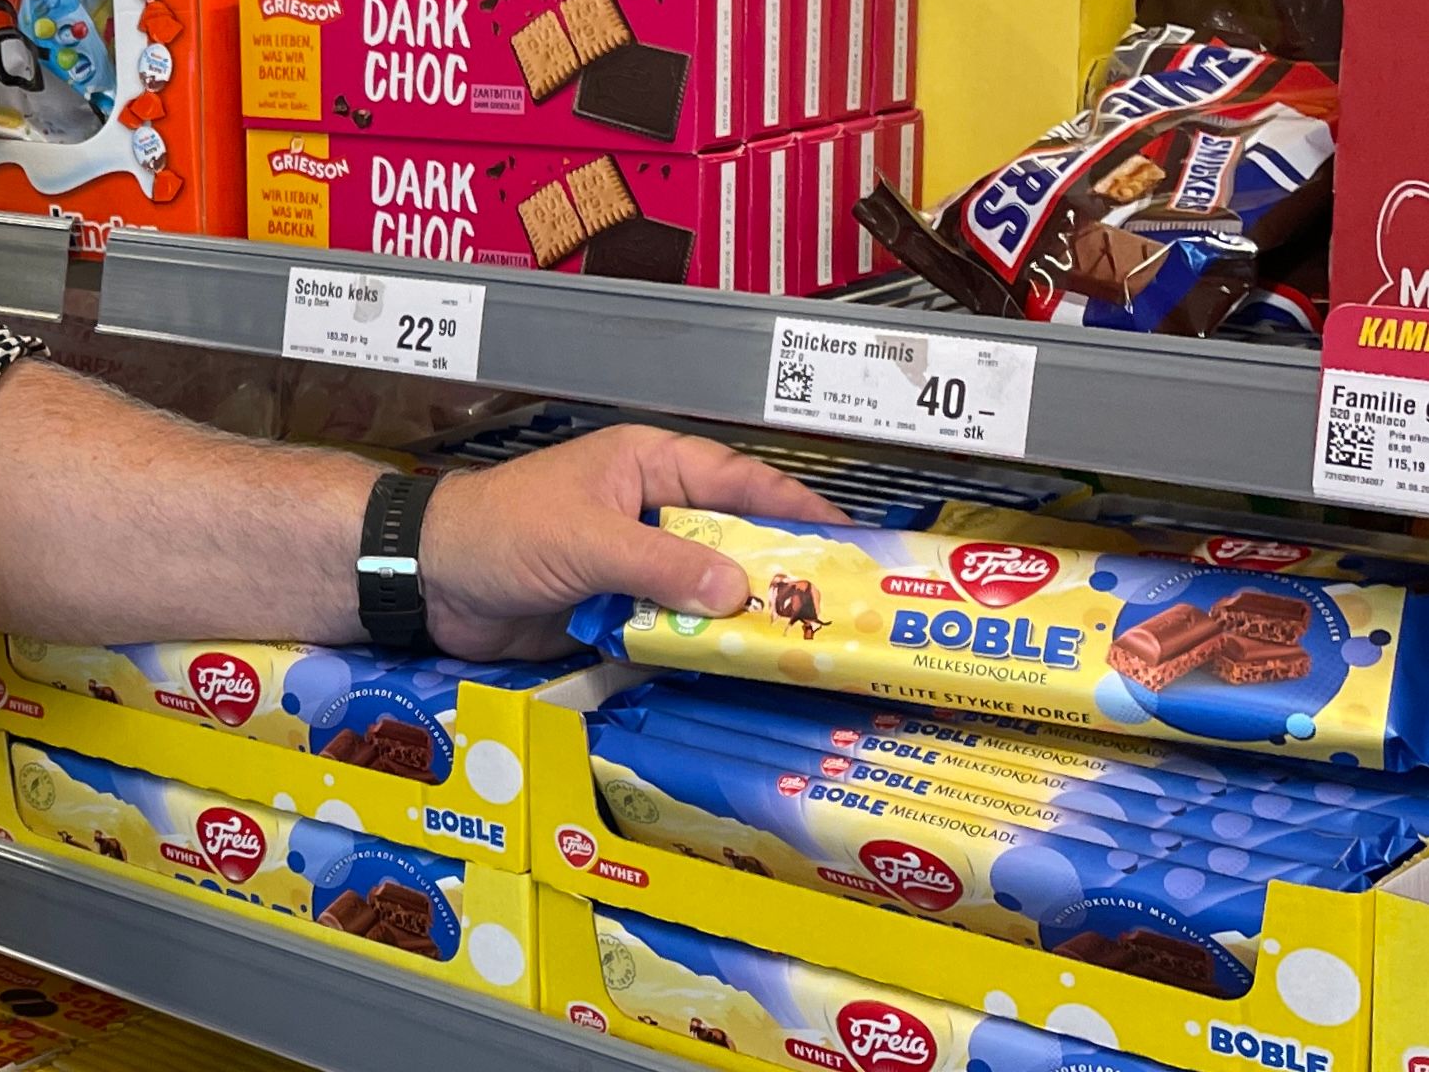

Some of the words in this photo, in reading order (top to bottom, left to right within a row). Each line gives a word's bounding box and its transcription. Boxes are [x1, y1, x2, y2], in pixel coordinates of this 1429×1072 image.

[364, 50, 468, 106] CHOC
[473, 88, 523, 100] ZARTBITTER
[271, 154, 350, 179] GRIESSON
[1178, 135, 1232, 211] SNICKERS
[262, 189, 281, 203] WIR
[371, 155, 478, 214] DARK
[271, 206, 292, 220] WAS
[372, 211, 475, 264] CHOC
[295, 278, 343, 299] Schoko
[348, 283, 379, 303] keks
[397, 315, 434, 352] 22
[438, 319, 457, 337] 90
[781, 330, 857, 356] Snickers
[864, 340, 914, 363] minis
[1357, 316, 1429, 352] KAM
[432, 357, 448, 370] stk
[780, 348, 796, 361] 227
[822, 391, 852, 405] 176,21
[867, 397, 878, 409] kg
[1332, 385, 1416, 415] Familie
[1330, 407, 1350, 420] 520
[1364, 411, 1407, 428] Malaco
[963, 426, 985, 441] stk
[1387, 457, 1425, 472] 115,19
[961, 547, 1050, 586] Freia
[890, 580, 947, 596] NYHET
[889, 609, 1084, 669] BOBLE
[197, 661, 255, 704] Freia
[913, 654, 1048, 686] MELKESJOKOLADE
[9, 700, 41, 716] NYHET
[160, 694, 196, 711] NYHET
[871, 682, 892, 694] ET
[899, 685, 937, 701] LITE
[944, 693, 1015, 713] STYKKE
[1023, 707, 1091, 724] NORGE
[903, 719, 982, 748] BOBLE
[861, 736, 941, 765] BOBLE
[941, 755, 1069, 791] MELKESJOKOLADE
[851, 765, 932, 795] BOBLE
[933, 783, 1062, 823] MELKESJOKOLADE
[425, 808, 504, 848] BOBLE
[808, 784, 889, 816] BOBLE
[889, 805, 1019, 846] MELKESJOKOLADE
[204, 816, 261, 859] Freia
[563, 835, 594, 856] Freia
[166, 847, 201, 866] NYHET
[874, 852, 956, 890] Freia
[600, 862, 642, 883] NYHET
[824, 869, 879, 891] NYHET
[850, 1013, 929, 1065] Freia
[794, 1043, 843, 1068] NYHET
